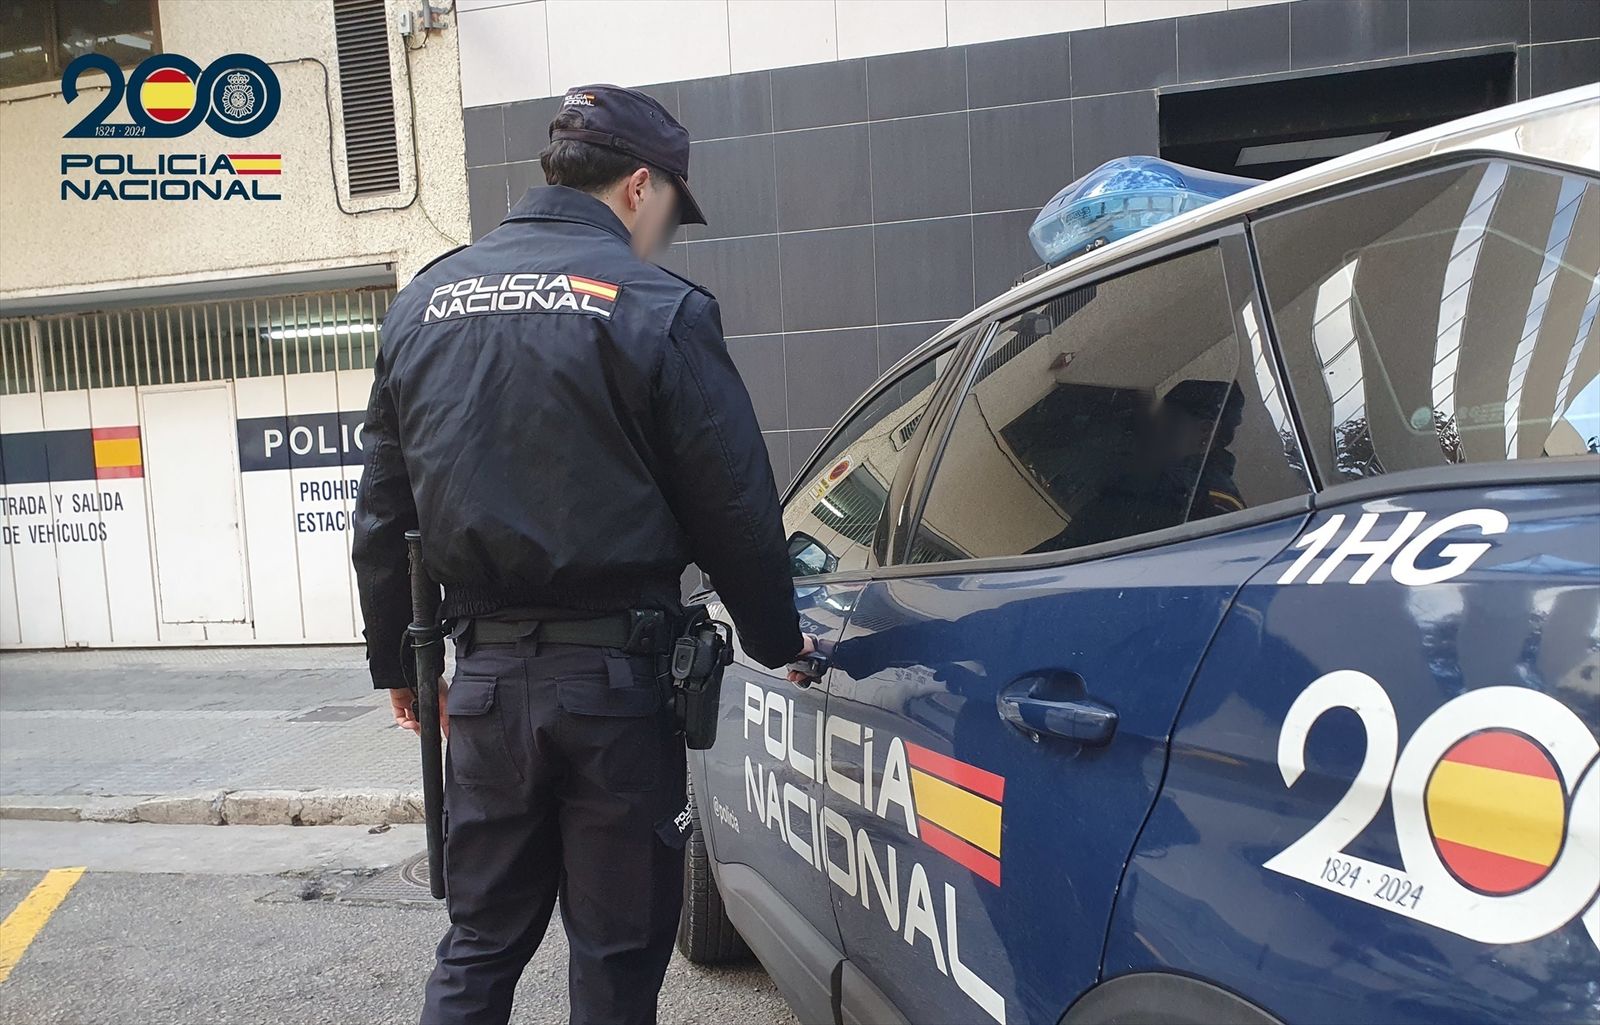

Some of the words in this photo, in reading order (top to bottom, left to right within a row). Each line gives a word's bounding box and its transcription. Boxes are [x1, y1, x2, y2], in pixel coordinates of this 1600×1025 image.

[424, 291, 610, 322] NACIONAL
[55, 494, 63, 514] Y
[72, 491, 124, 513] SALIDA
[300, 480, 359, 502] PROHIB
[2, 526, 21, 545] DE
[28, 518, 107, 544] VEHÍCULOS
[1276, 508, 1510, 586] 1HG
[745, 755, 1007, 1025] NACIONAL
[1320, 857, 1361, 888] 1824
[1374, 873, 1424, 909] 2024
